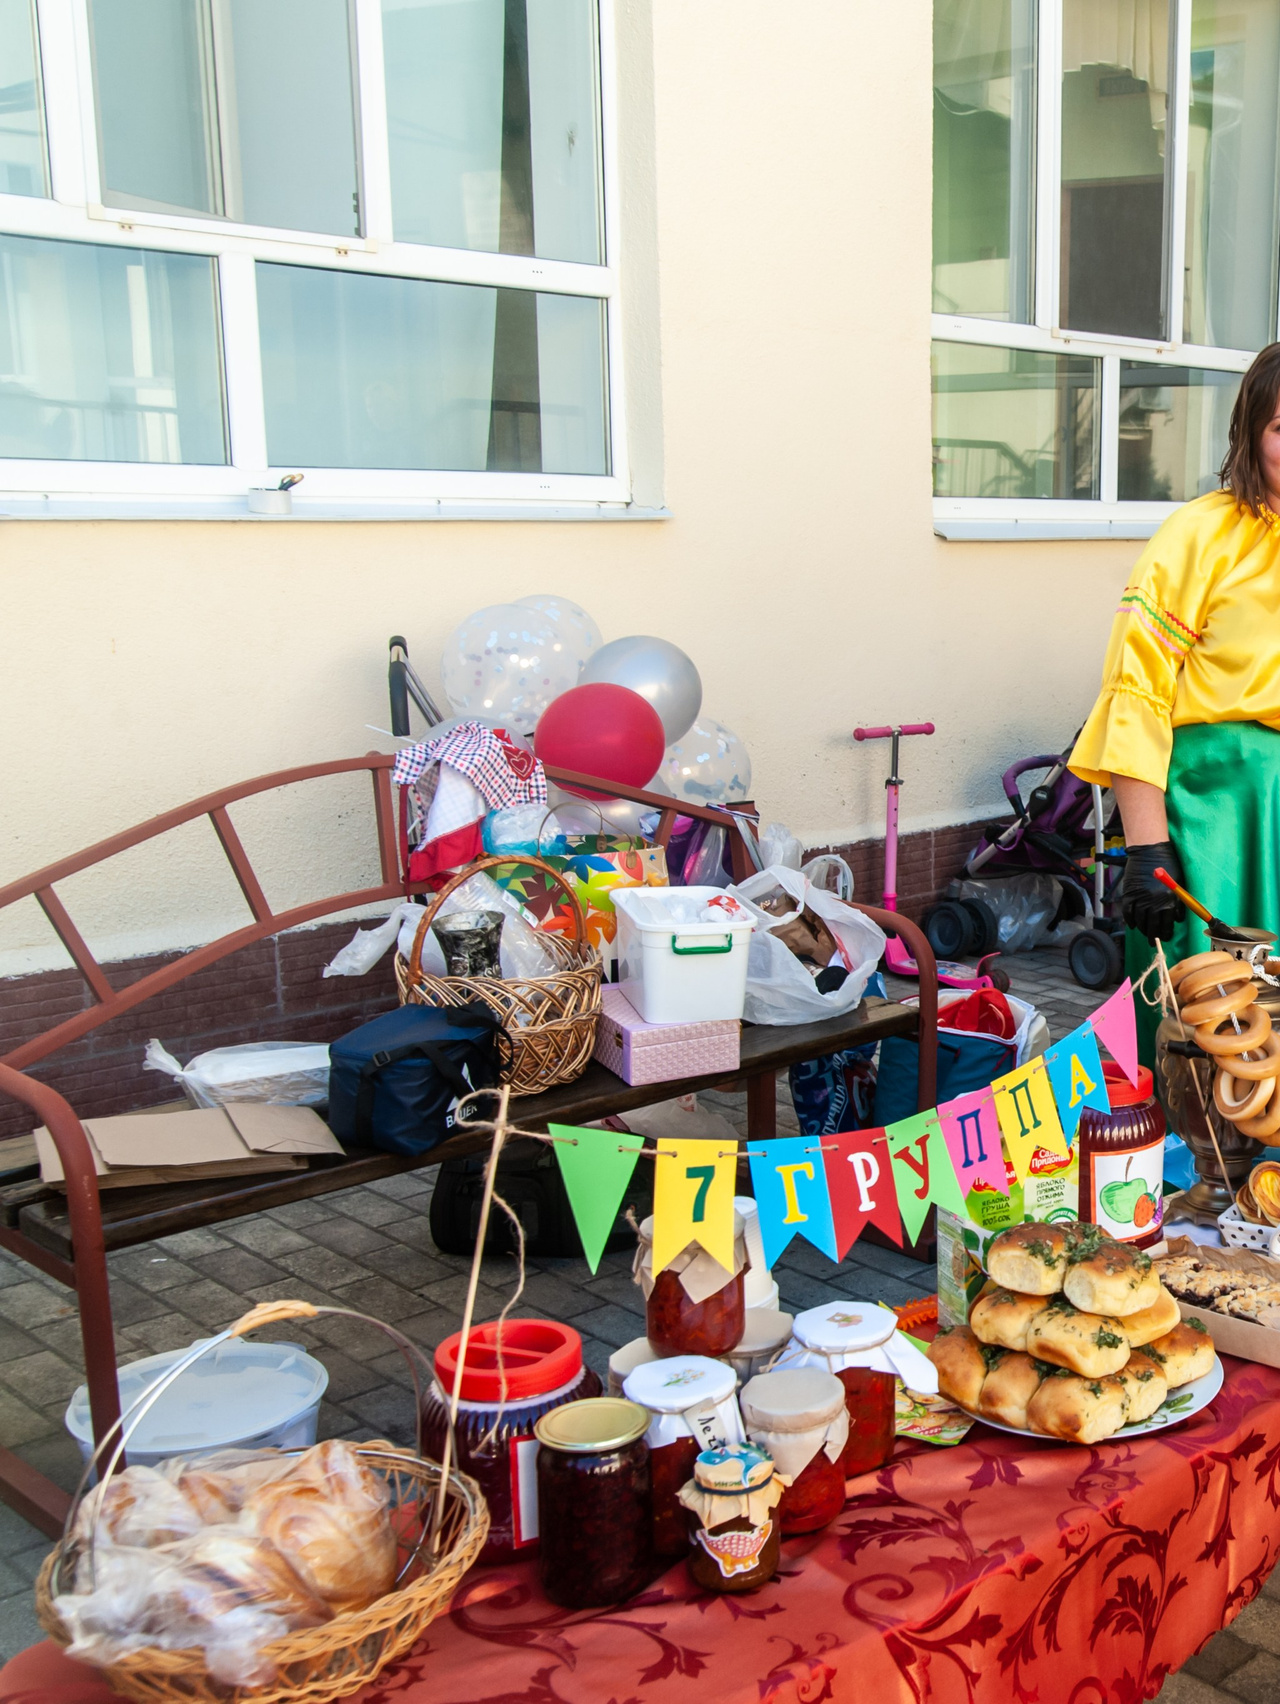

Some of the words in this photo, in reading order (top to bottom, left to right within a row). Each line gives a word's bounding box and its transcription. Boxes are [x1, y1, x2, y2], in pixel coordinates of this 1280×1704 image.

[685, 1165, 716, 1223] 7
[774, 1051, 1097, 1225] ГРУППА
[1036, 1178, 1065, 1189] ЯБЛОКО
[1037, 1185, 1065, 1196] ПРЯМОГО
[982, 1196, 1010, 1206] ЯБЛОКО
[1037, 1192, 1064, 1202] ОТЖИМА
[981, 1202, 1010, 1214] ГРУША
[998, 1214, 1011, 1223] СОК
